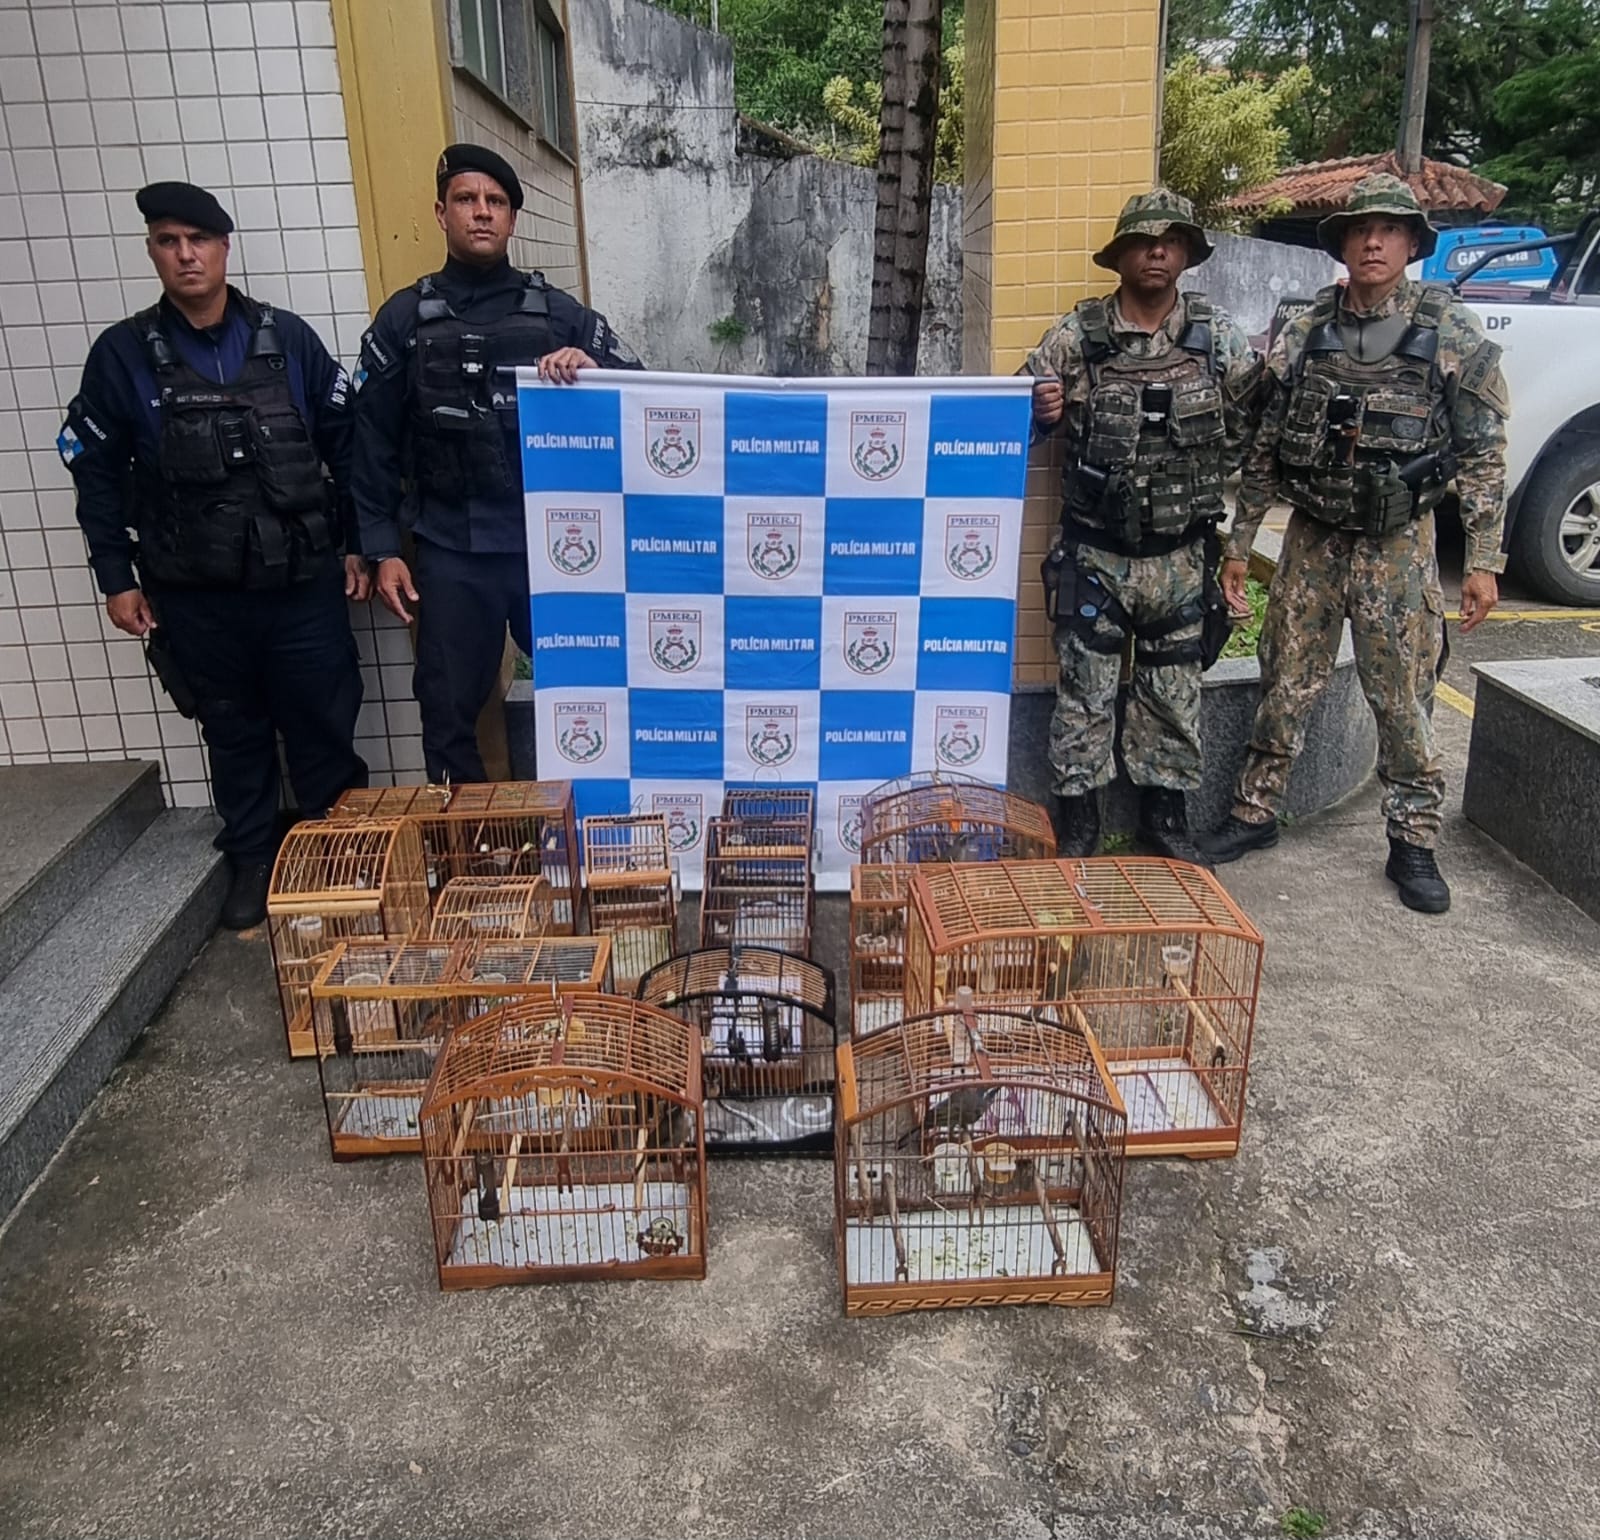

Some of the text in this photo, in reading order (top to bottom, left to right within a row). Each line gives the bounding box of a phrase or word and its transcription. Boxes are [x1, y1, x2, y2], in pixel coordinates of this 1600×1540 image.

[1486, 316, 1512, 330] DP
[649, 411, 696, 420] PMERJ
[855, 414, 902, 422] PMERJ
[526, 433, 614, 450] POLÍCIA MILITAR
[731, 437, 819, 454] POLÍCIA MILITAR
[934, 440, 1022, 456] POLÍCIA MILITAR
[550, 512, 597, 520] PMERJ
[752, 516, 797, 524] PMERJ
[951, 518, 997, 526] PMERJ
[631, 537, 717, 553] POLÍCIA MILITAR
[830, 540, 916, 555] POLÍCIA MILITAR
[652, 612, 697, 621] PMERJ
[849, 615, 893, 623] PMERJ
[536, 633, 620, 649] POLÍCIA MILITAR
[730, 636, 815, 651] POLÍCIA MILITAR
[923, 637, 1007, 654] POLÍCIA MILITAR
[558, 705, 602, 713] PMERJ
[750, 708, 794, 716] PMERJ
[940, 708, 983, 716] PMERJ
[635, 728, 717, 742] POLÍCIA MILITAR
[825, 729, 907, 743] POLÍCIA MILITAR
[656, 796, 699, 804] PMERJ
